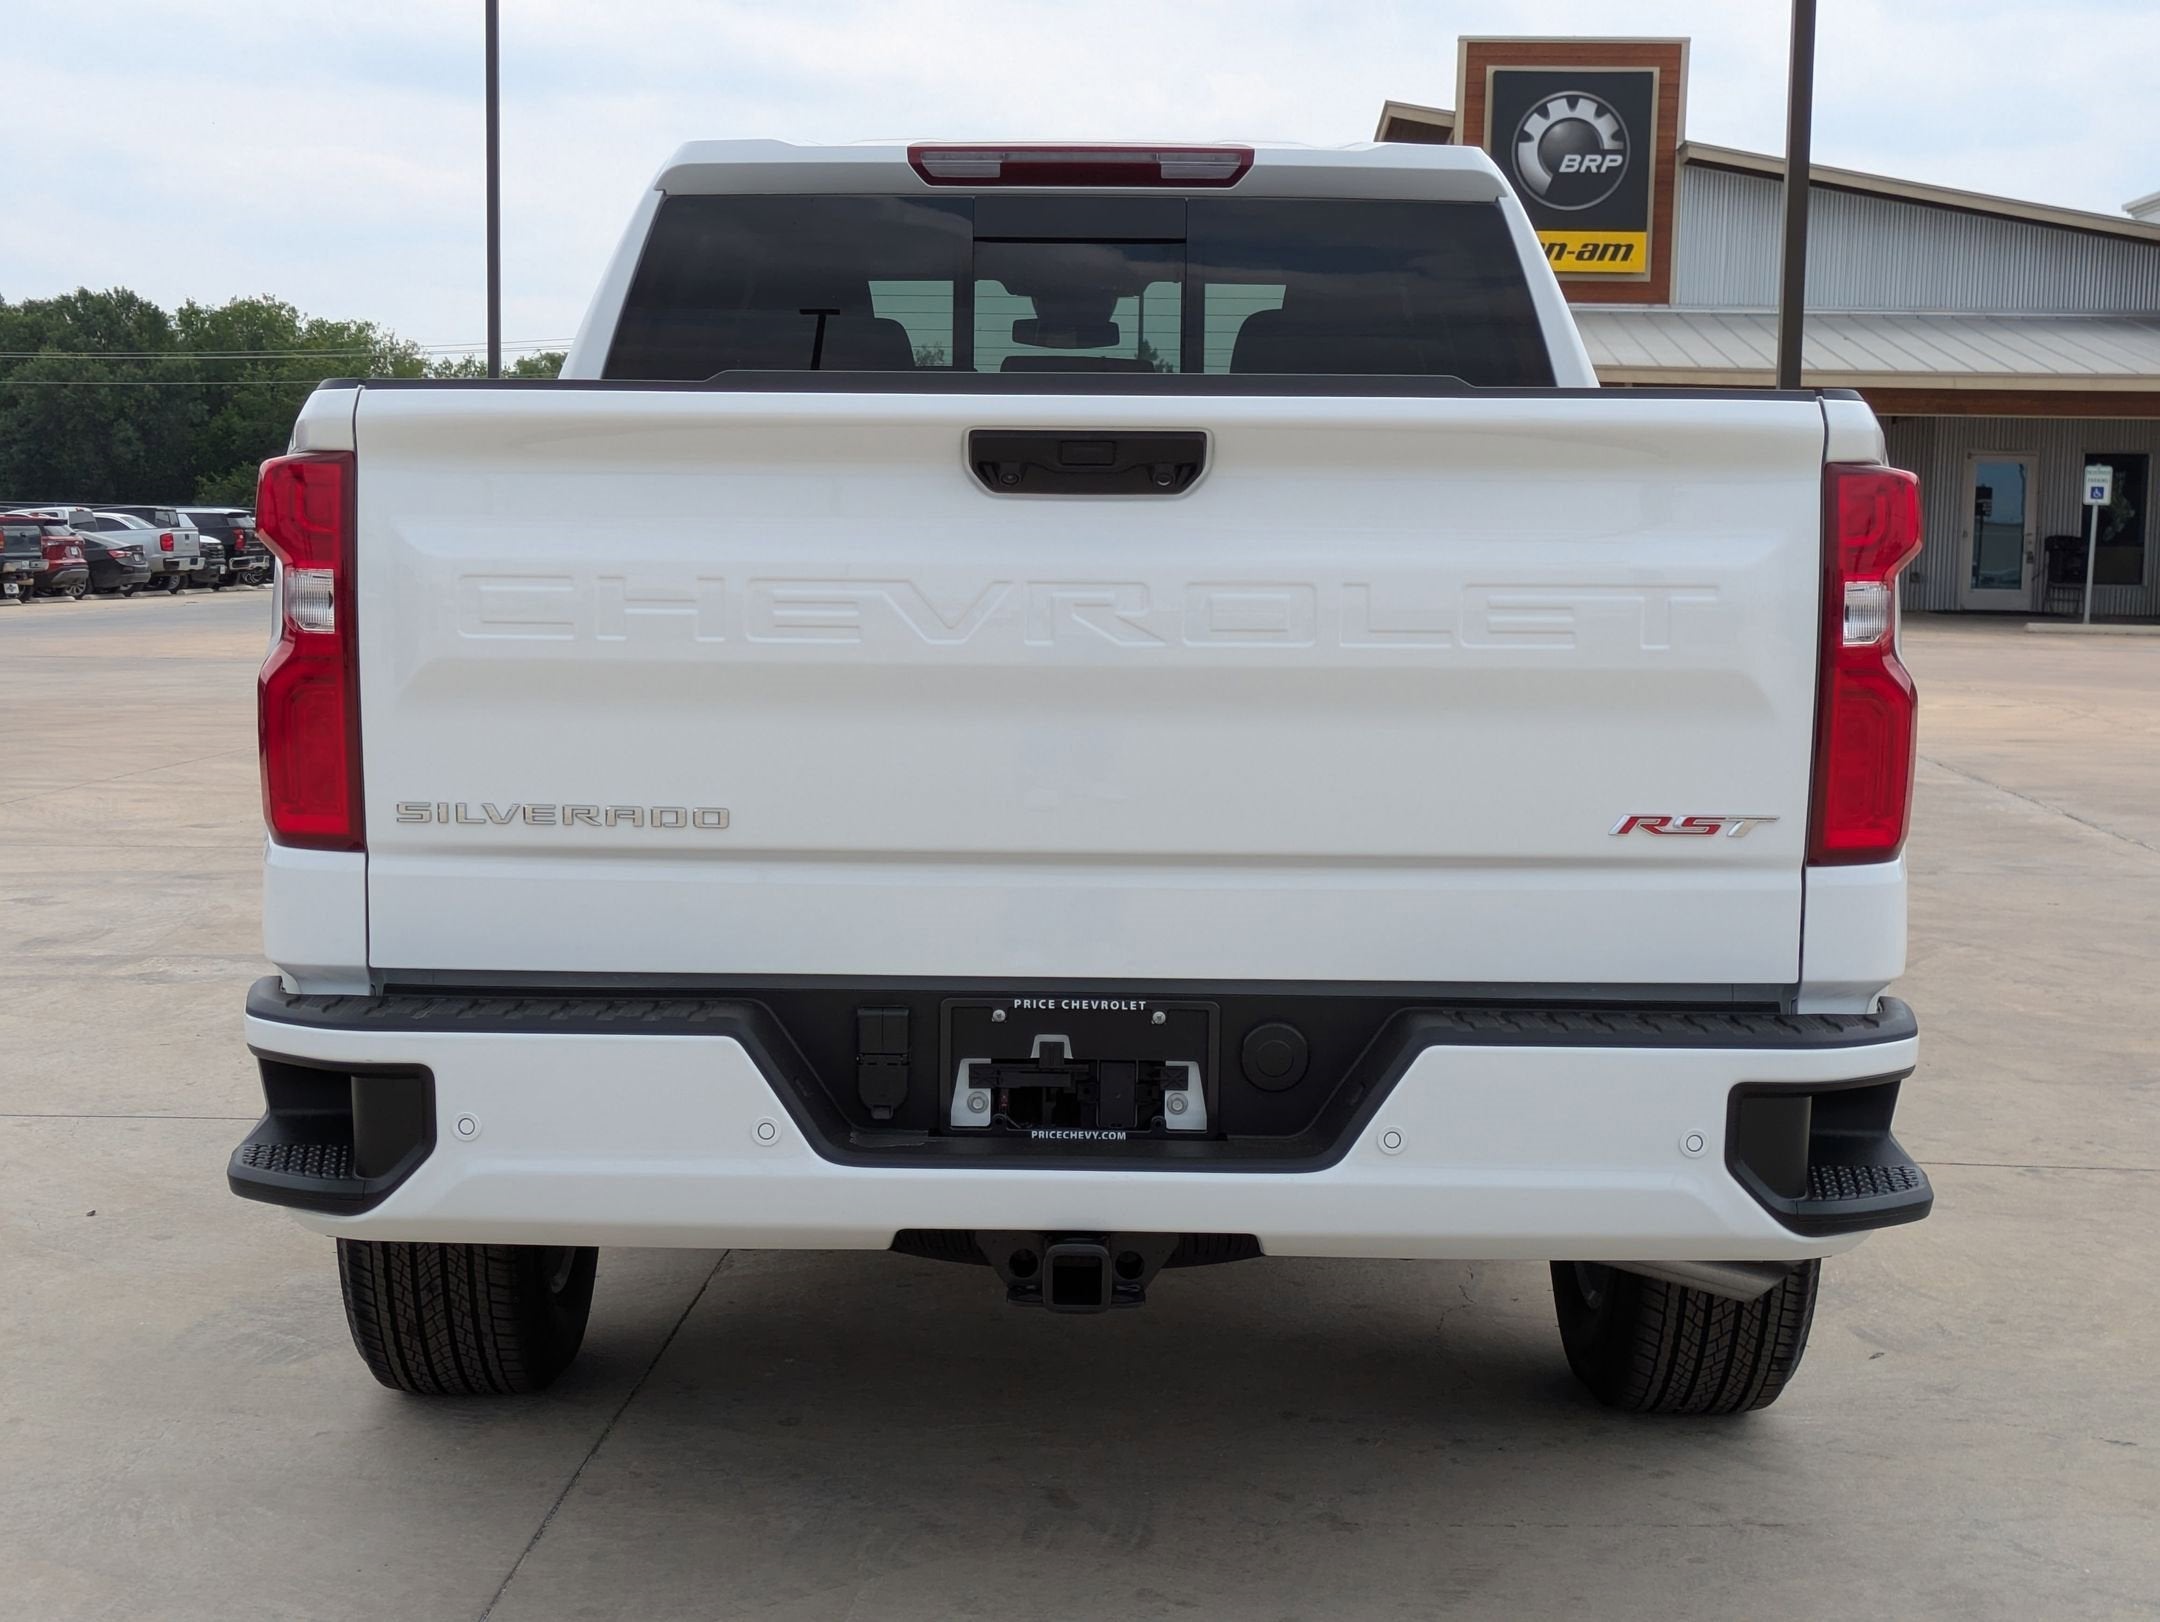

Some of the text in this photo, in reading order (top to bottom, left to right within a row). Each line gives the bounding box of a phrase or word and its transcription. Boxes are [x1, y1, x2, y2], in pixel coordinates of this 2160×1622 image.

[1558, 154, 1623, 174] BRP
[1541, 242, 1634, 262] n-am
[458, 574, 1720, 651] CHEVROLET
[396, 801, 730, 830] SILVERADO
[1608, 814, 1780, 837] RST
[1013, 999, 1147, 1011] PRICE CHEVROLET
[1031, 1130, 1127, 1141] PRICECHEVY.COM
